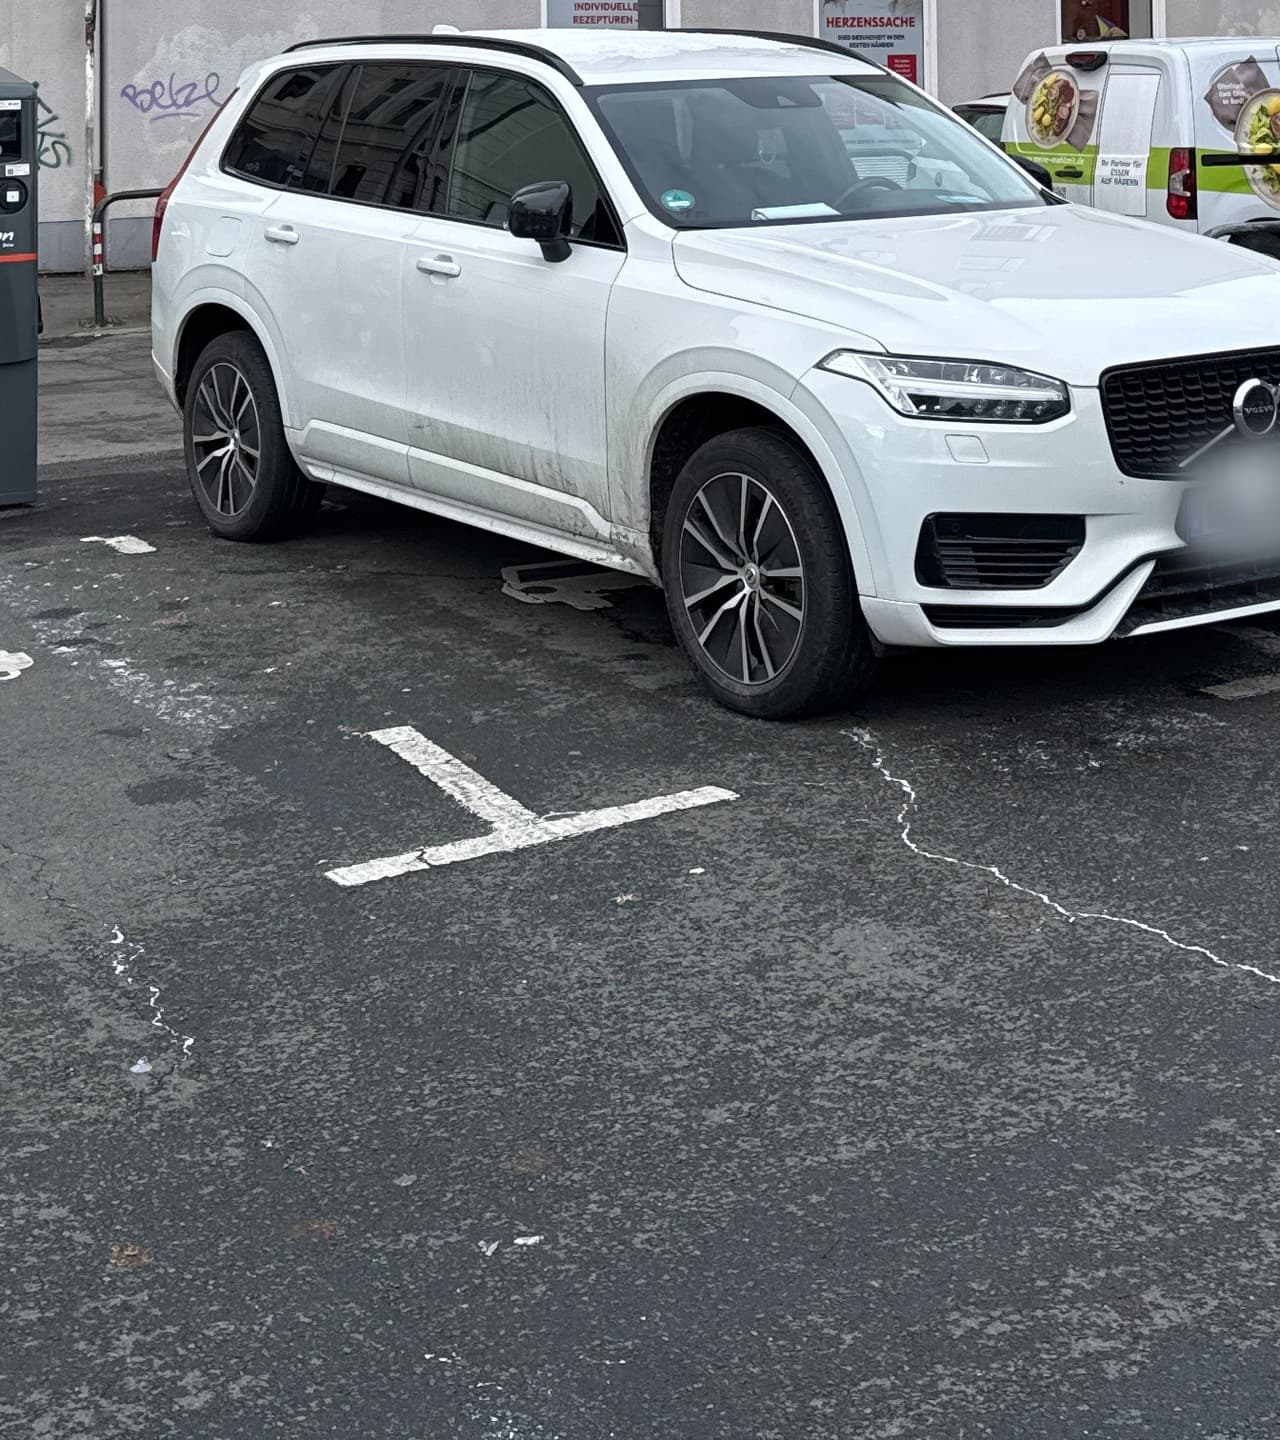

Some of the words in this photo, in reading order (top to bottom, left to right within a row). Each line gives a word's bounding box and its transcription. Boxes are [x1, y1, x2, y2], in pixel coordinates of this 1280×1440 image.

[574, 2, 639, 11] INDIVIDUELLE
[573, 15, 633, 24] REZEPTUREN
[826, 16, 916, 28] HERZENSSACHE
[1244, 405, 1274, 414] VOLVO
